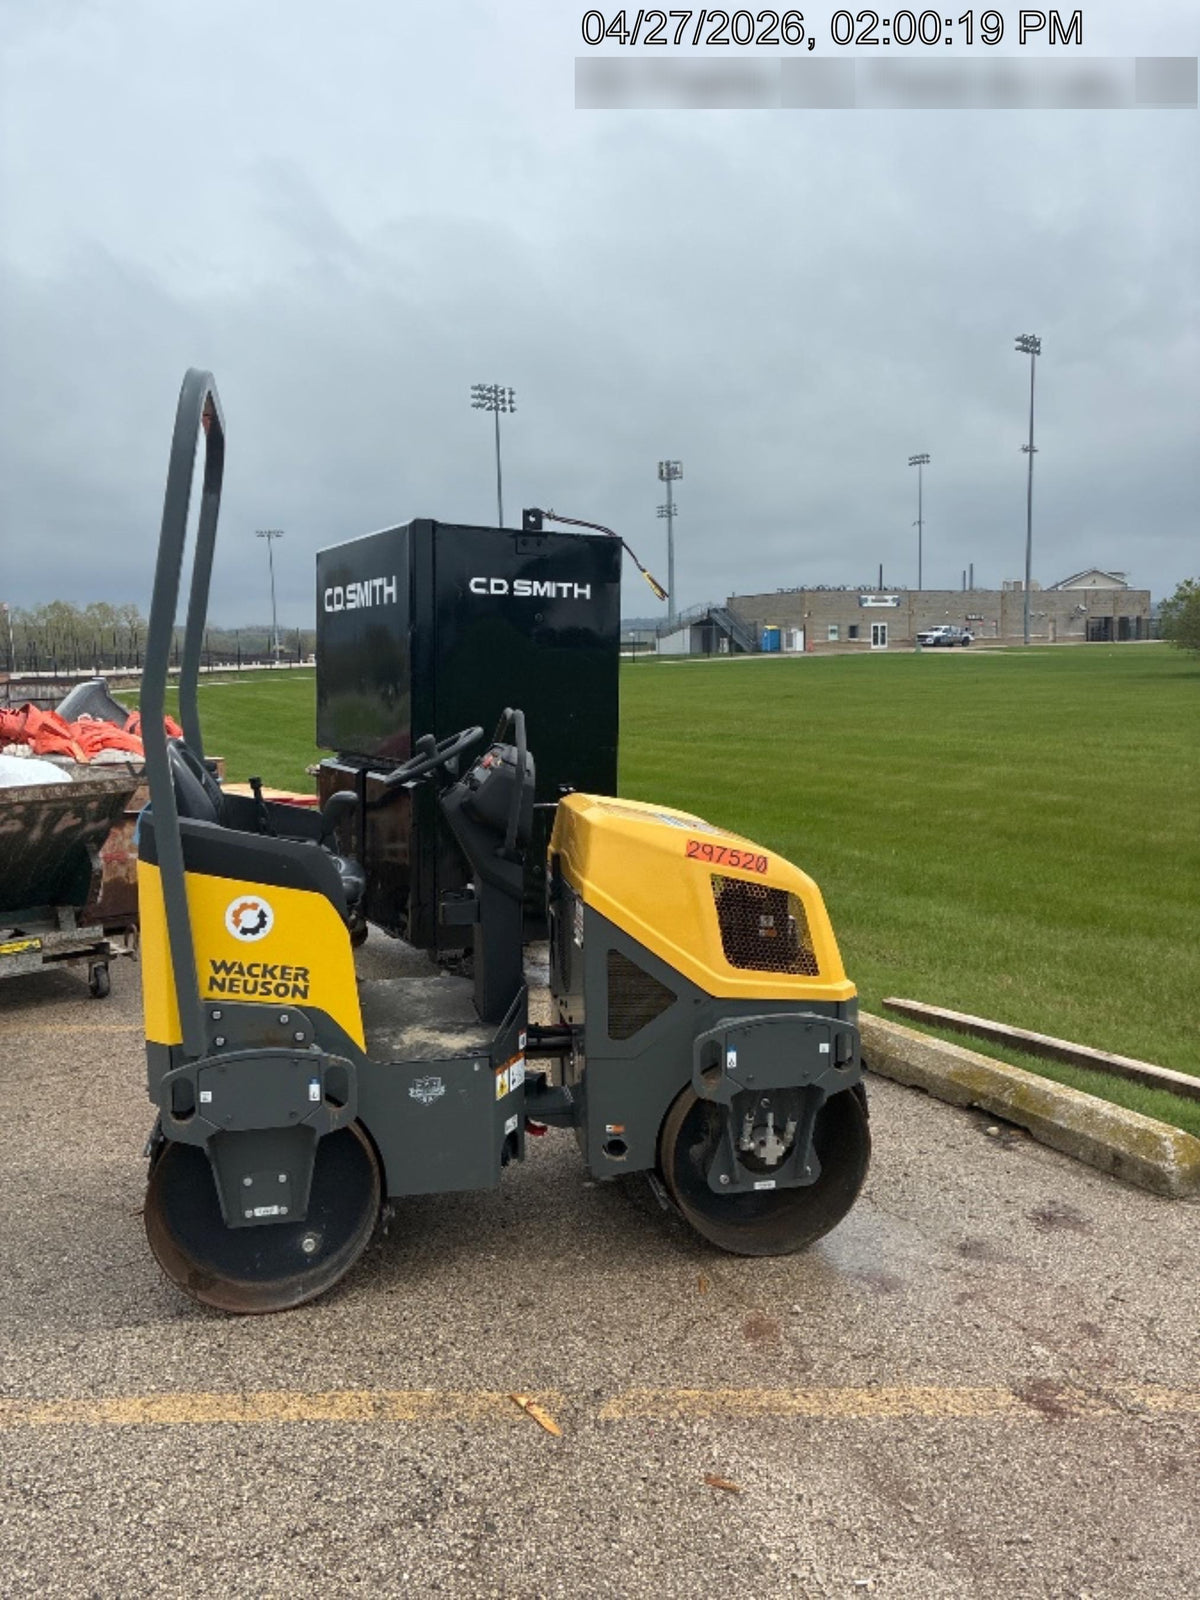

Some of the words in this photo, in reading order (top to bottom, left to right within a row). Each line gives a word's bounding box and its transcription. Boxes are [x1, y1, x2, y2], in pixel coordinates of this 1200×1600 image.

[346, 575, 397, 610] SMITH
[513, 579, 591, 600] SMITH
[686, 840, 769, 874] 297520
[209, 959, 310, 983] WACKER
[208, 976, 310, 1000] NEUSON
